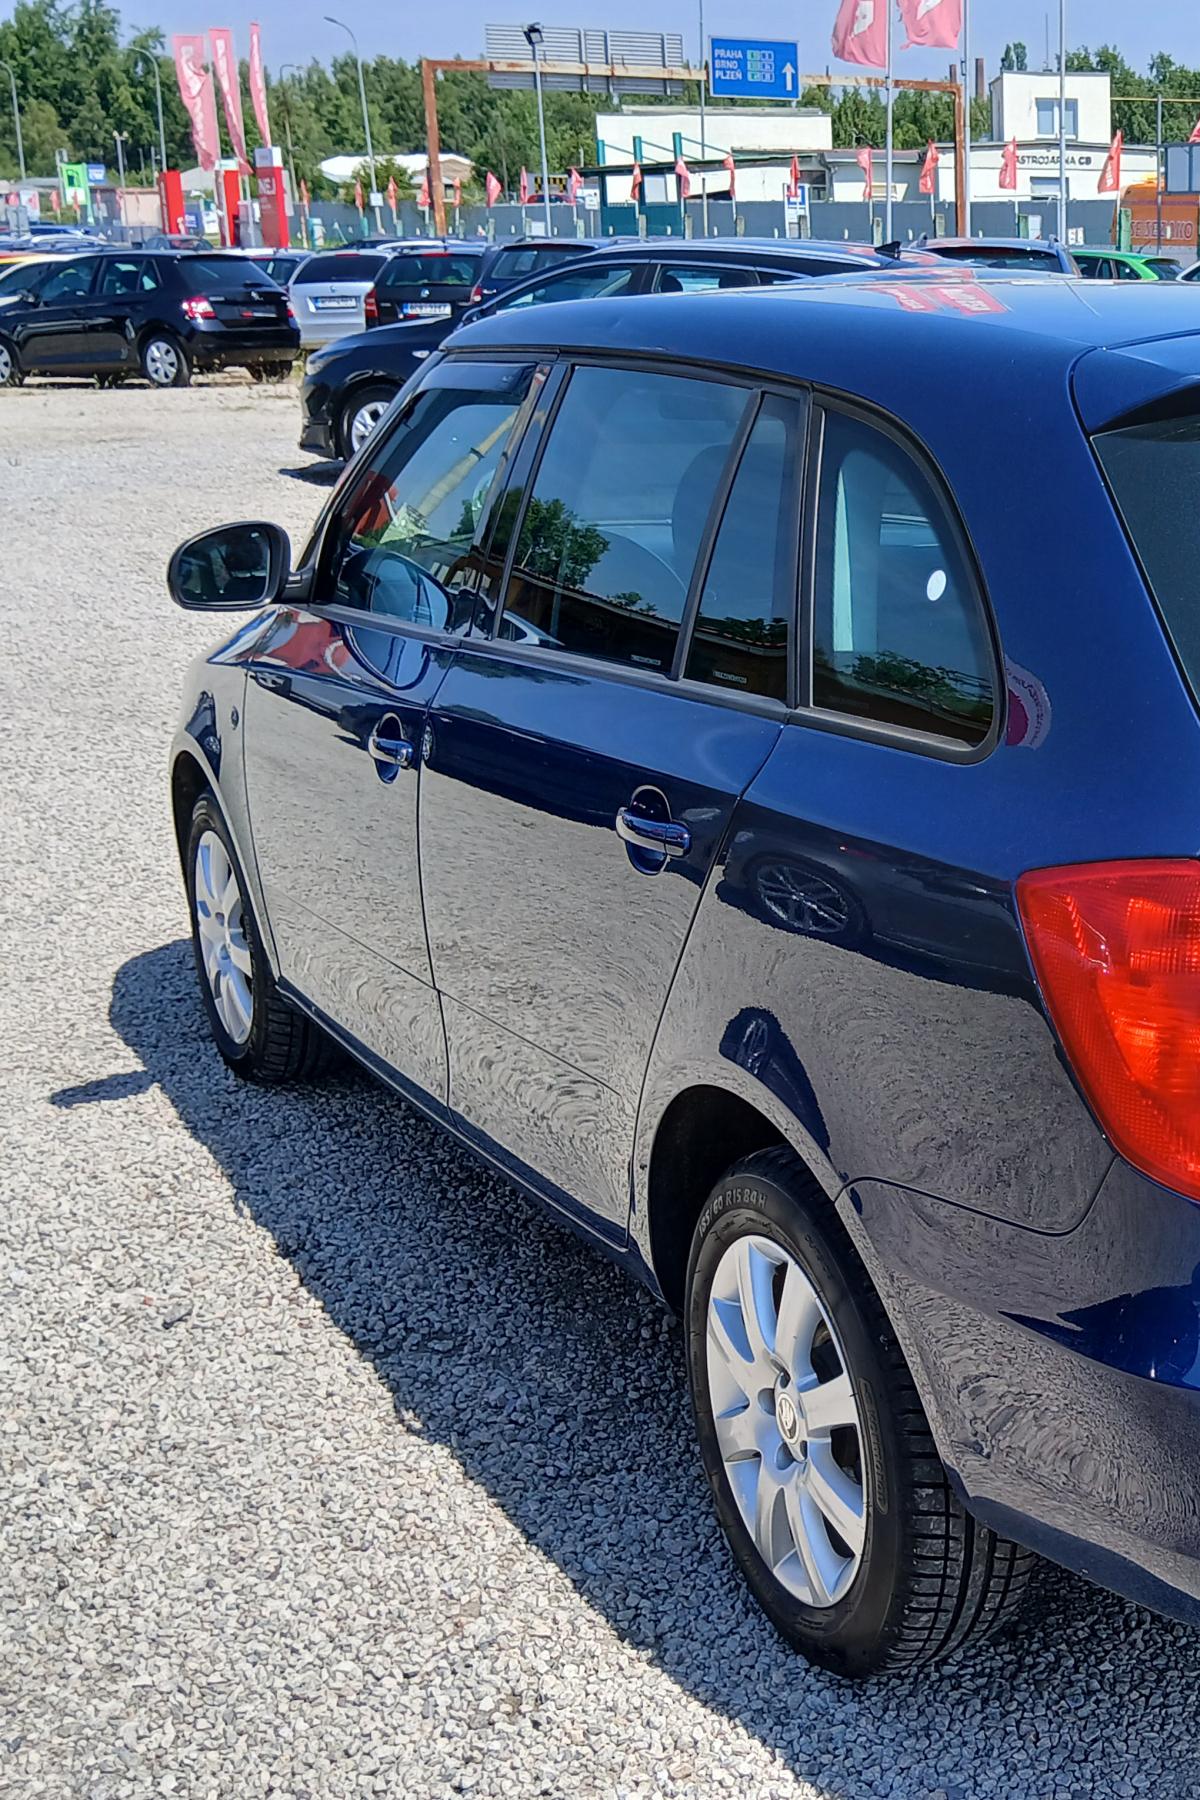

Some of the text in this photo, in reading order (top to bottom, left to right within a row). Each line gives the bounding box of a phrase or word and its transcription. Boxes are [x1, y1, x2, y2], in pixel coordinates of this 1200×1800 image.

[714, 49, 743, 59] PRAHA
[715, 60, 738, 69] BRNO
[715, 69, 742, 80] PLZEŇ
